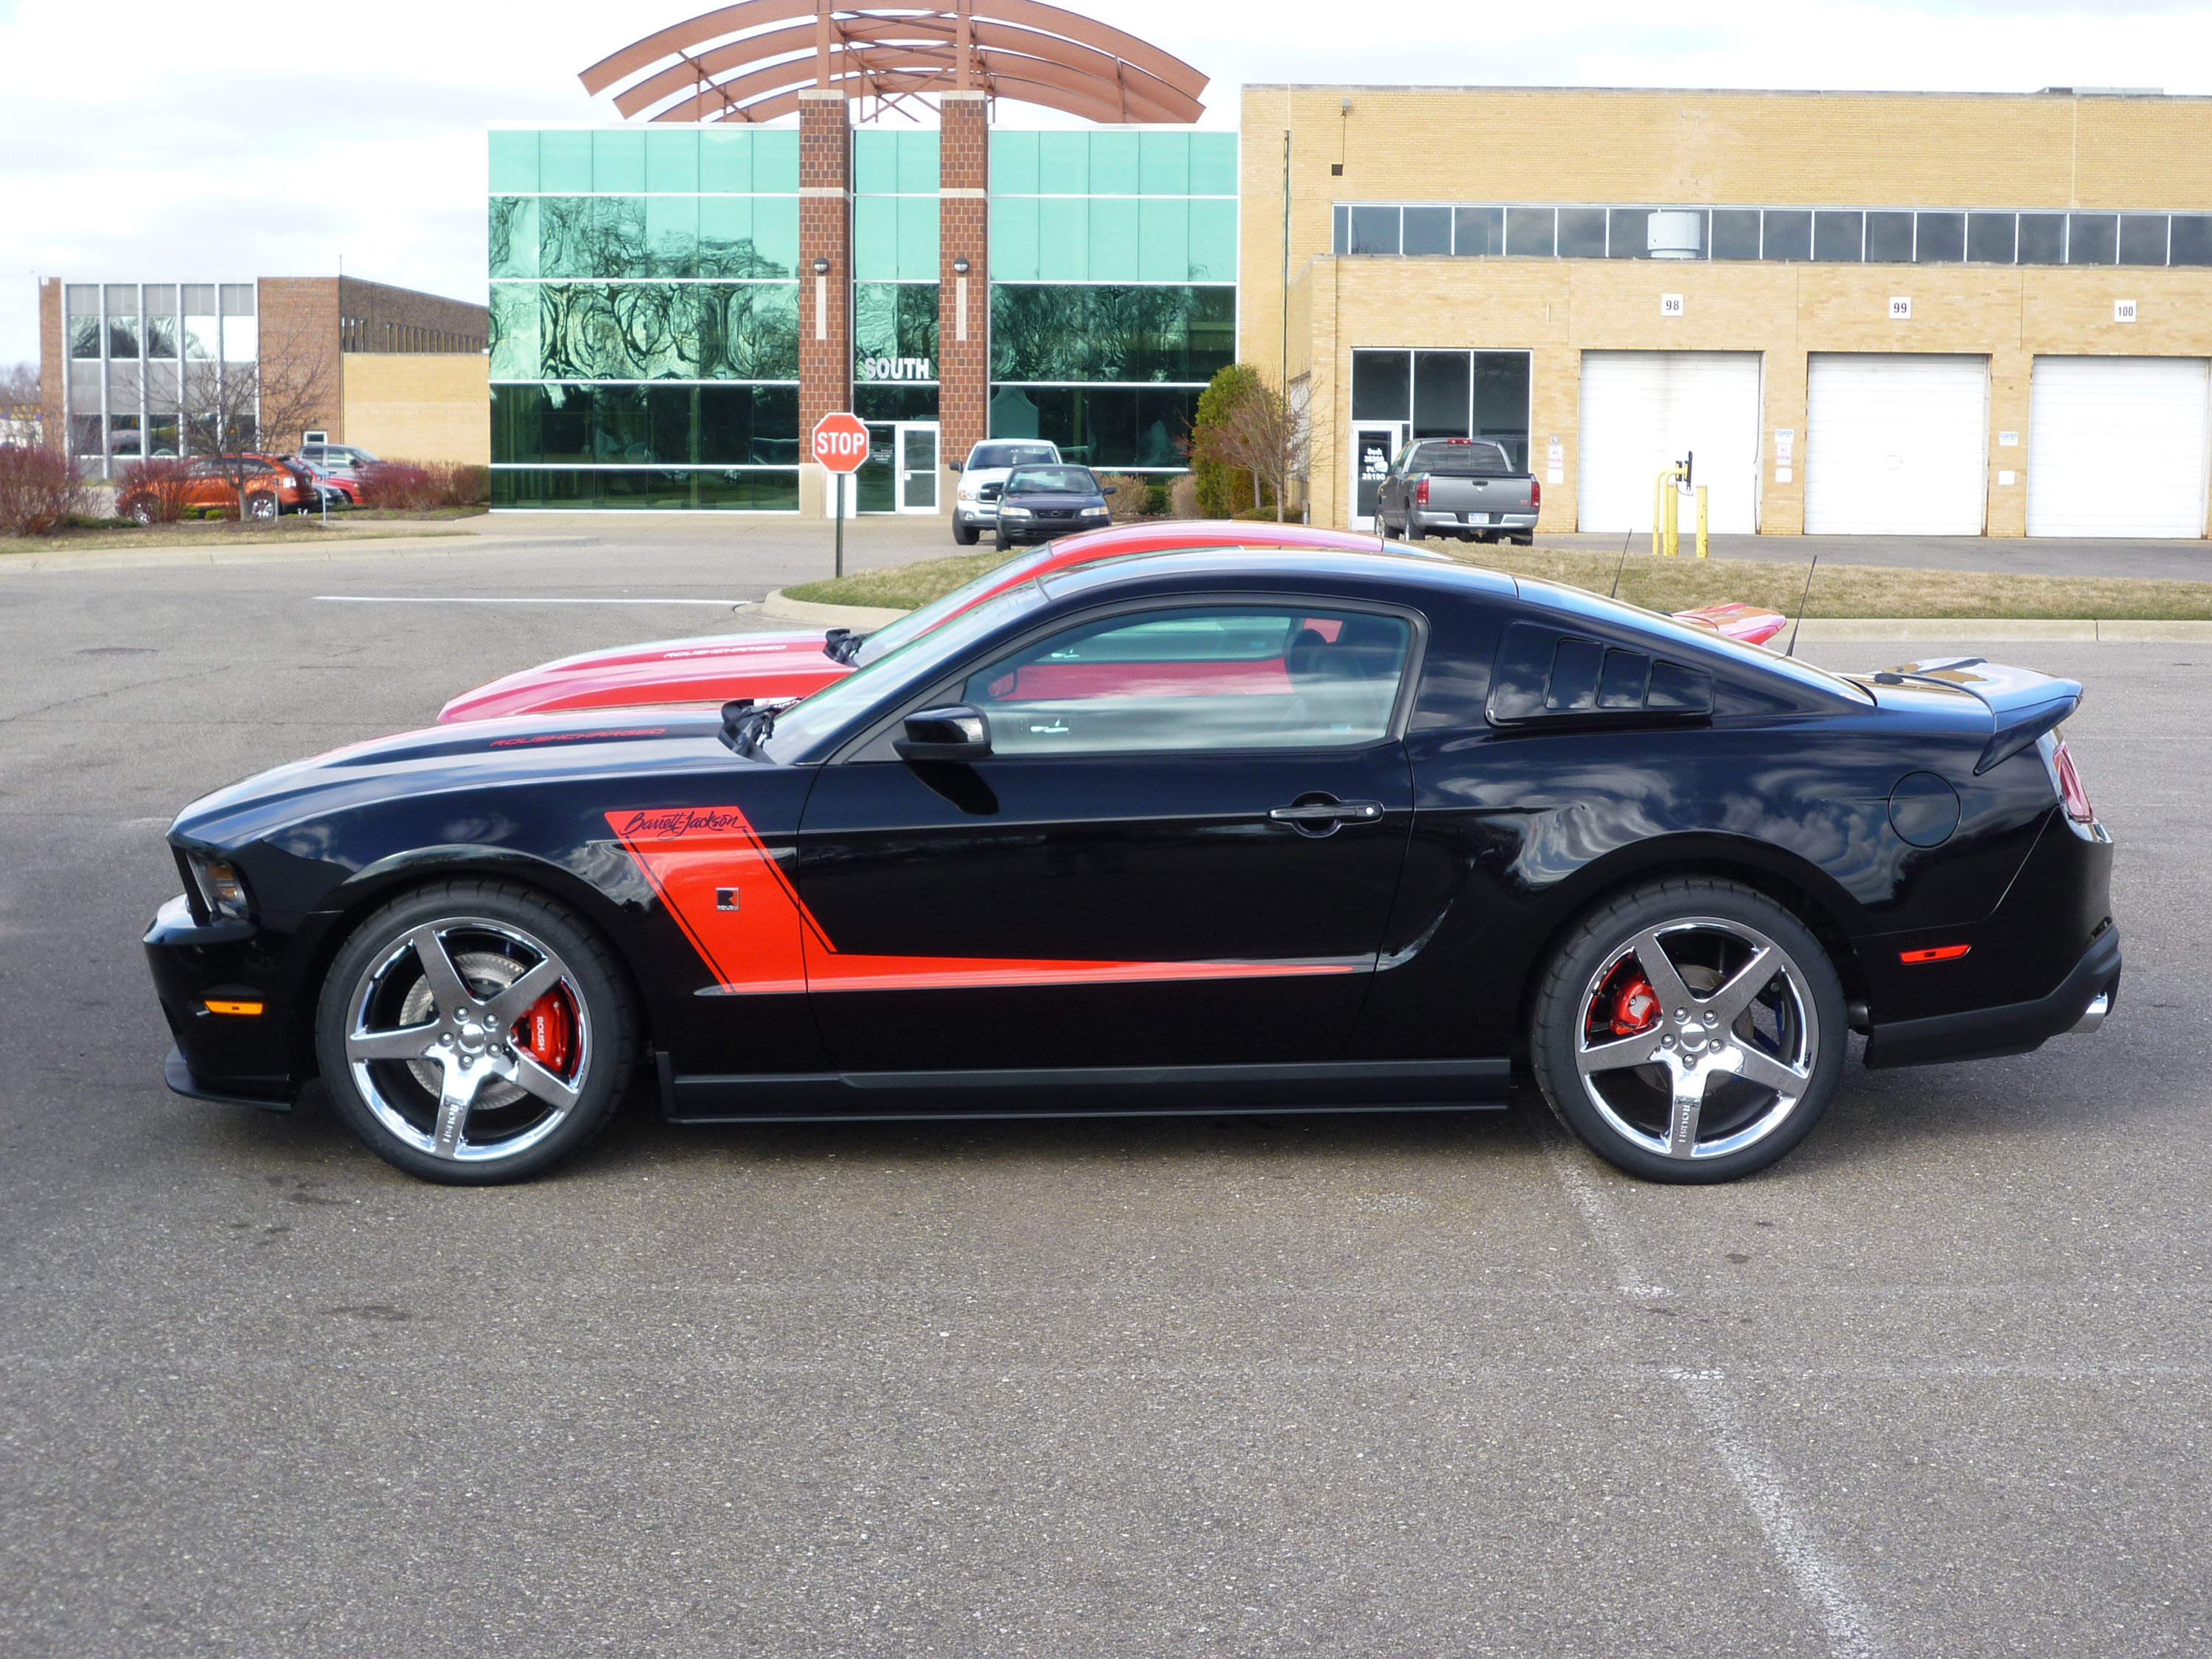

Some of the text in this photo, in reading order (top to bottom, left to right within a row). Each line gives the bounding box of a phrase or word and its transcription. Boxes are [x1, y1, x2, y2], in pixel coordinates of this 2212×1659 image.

[1666, 299, 1679, 310] 98
[1893, 302, 1907, 313] 99
[2118, 306, 2133, 316] 100
[865, 357, 929, 380] SOUTH
[816, 431, 865, 455] STOP
[490, 728, 666, 747] ROUSHCHARGED
[619, 810, 747, 841] Barrett-Jackson
[537, 1016, 545, 1051] ROUSH
[442, 1104, 459, 1143] ROUSH
[1678, 1105, 1690, 1143] ROUSH
